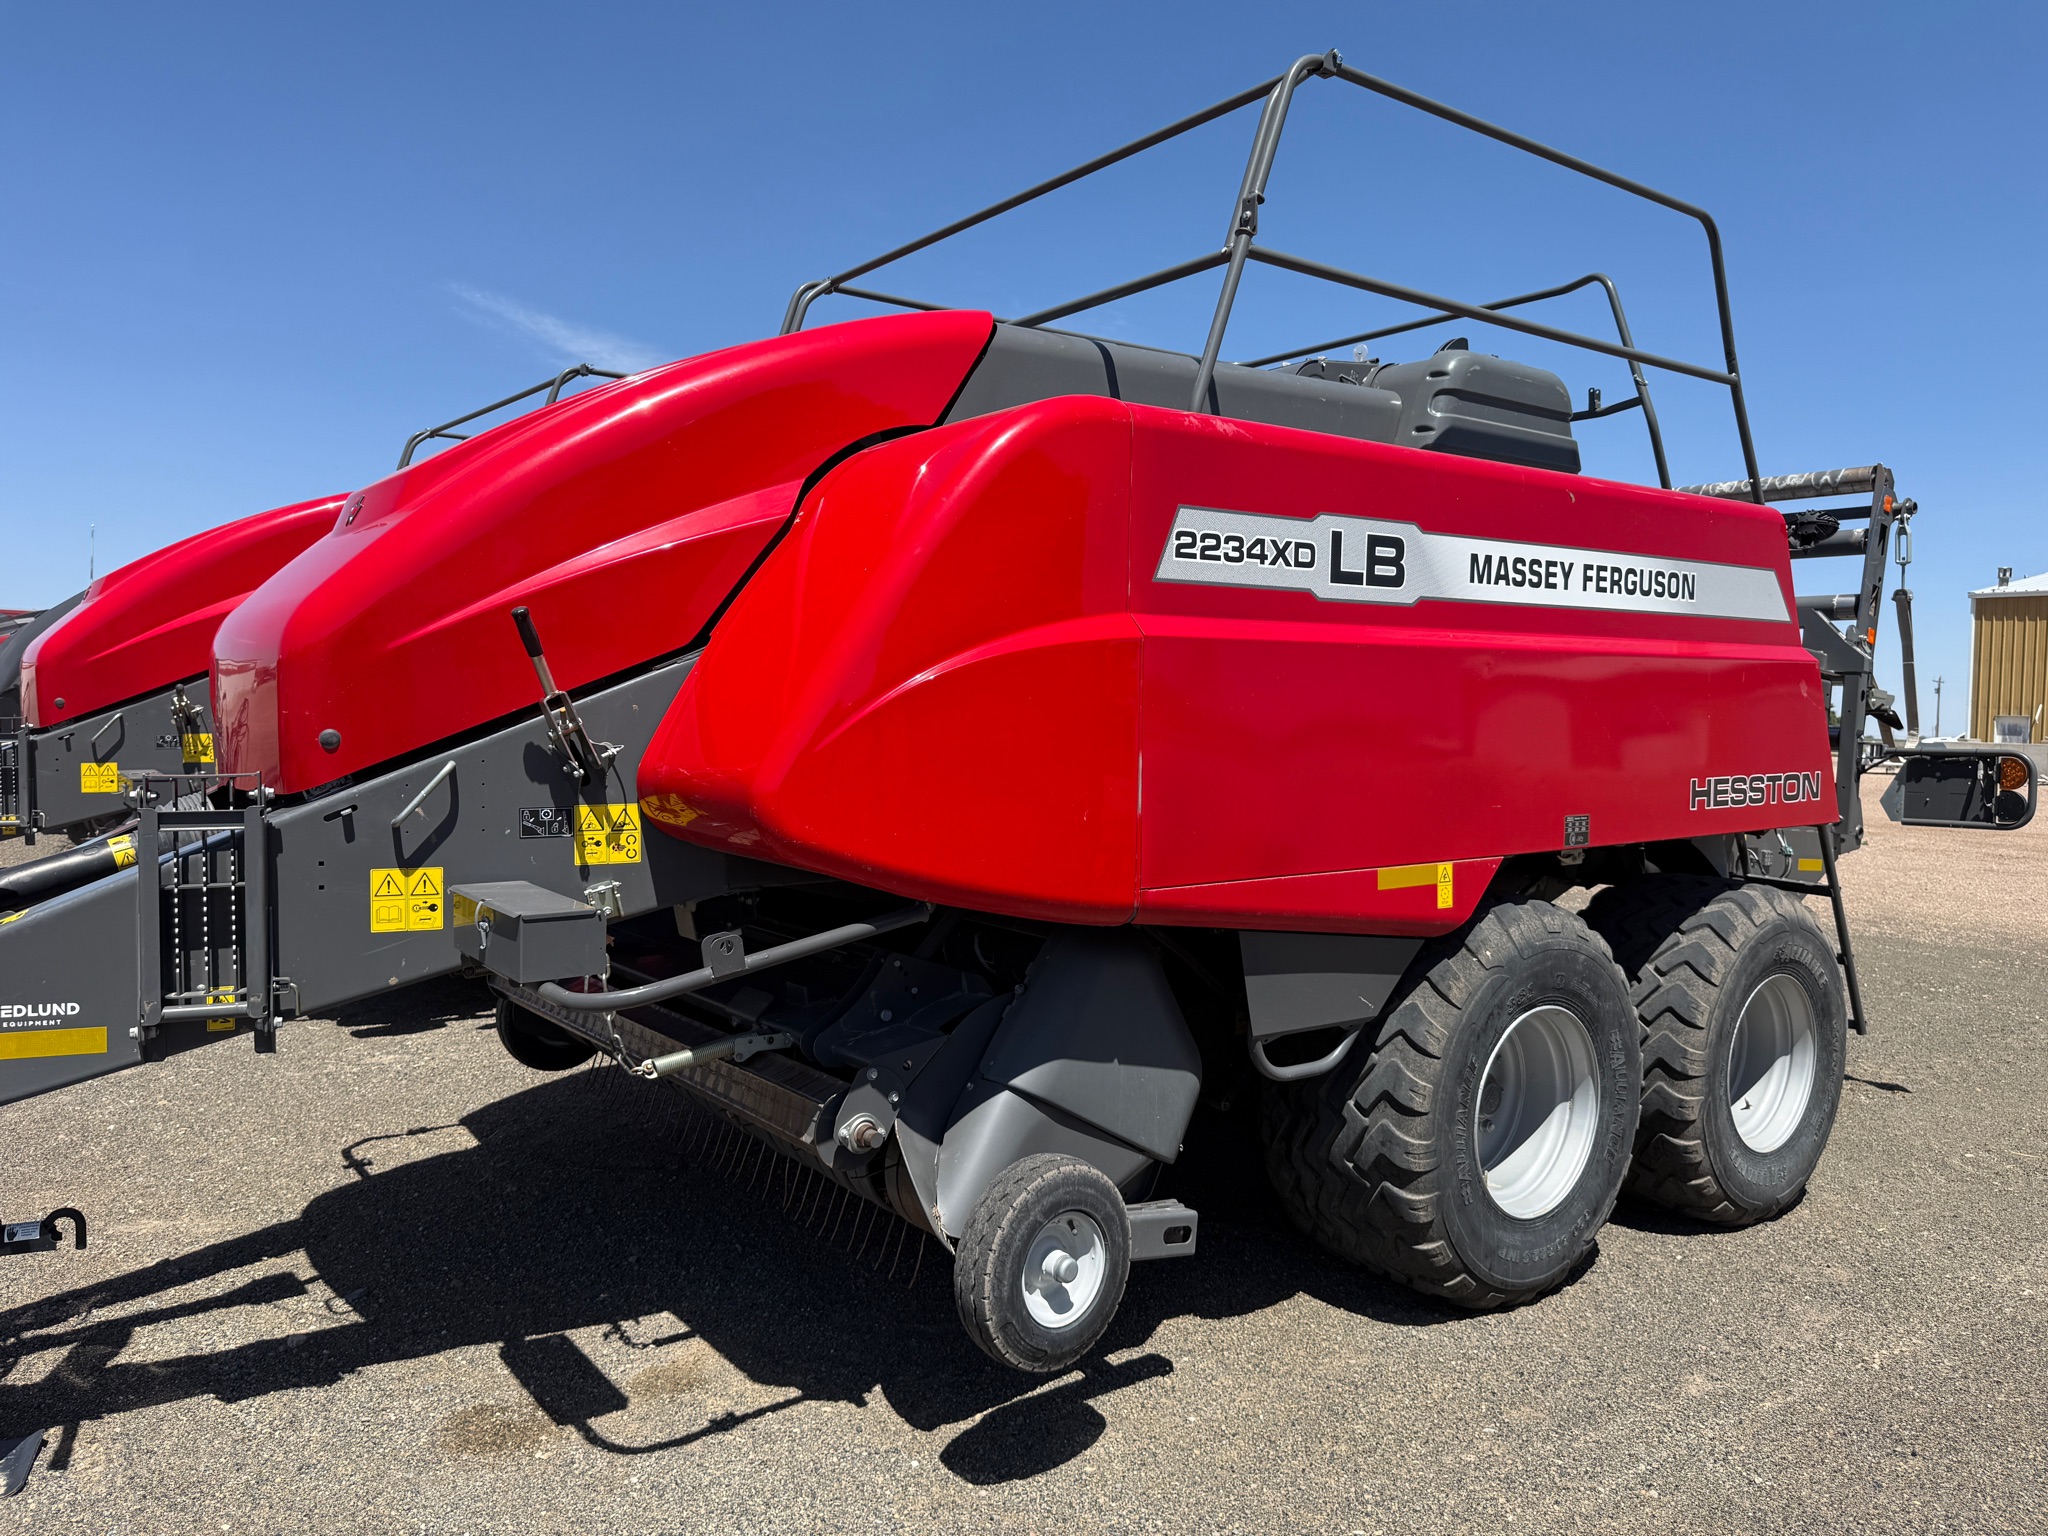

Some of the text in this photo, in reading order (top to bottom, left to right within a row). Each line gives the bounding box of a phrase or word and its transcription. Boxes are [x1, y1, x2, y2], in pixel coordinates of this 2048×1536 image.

[1174, 529, 1316, 570] 2234XD
[1329, 529, 1406, 588] LB
[1469, 553, 1696, 601] MASSEY FERGUSON
[1689, 771, 1821, 810] HESSTON
[0, 1002, 80, 1018] EDLUND
[2, 1019, 62, 1028] EQUIPMENT
